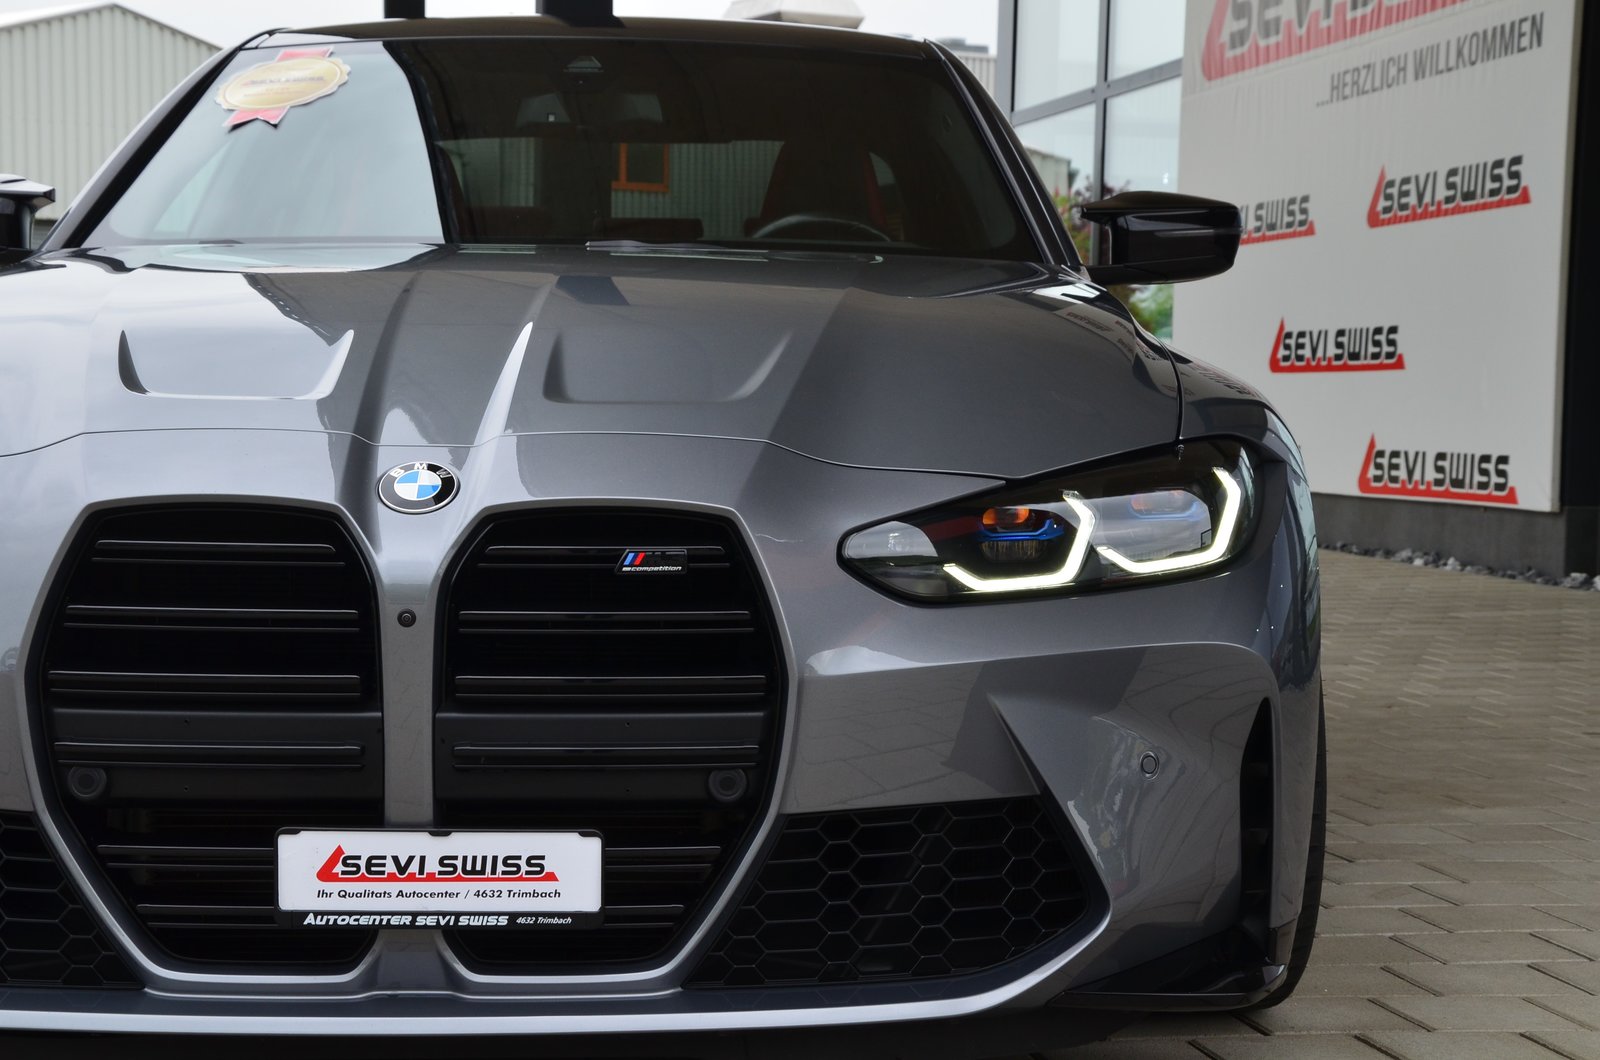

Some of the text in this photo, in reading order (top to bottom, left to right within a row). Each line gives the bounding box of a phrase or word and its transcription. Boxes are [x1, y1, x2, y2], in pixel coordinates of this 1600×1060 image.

[1413, 12, 1545, 82] WILLKOMMEN
[1381, 154, 1524, 216] SEVI SWISS
[1253, 194, 1311, 234] SWISS
[1281, 325, 1399, 363] SEVI SWISS
[389, 462, 452, 478] BMW
[1372, 450, 1510, 493] SEVI SWISS
[340, 854, 546, 877] SEVI SWISS
[316, 889, 333, 899] Ihr
[337, 888, 393, 900] Qualitats
[395, 889, 461, 899] Autocenter
[473, 889, 503, 899] 4632
[506, 889, 561, 899] Trimbach
[303, 912, 572, 926] AUTOCENTER SEVI SWISS 4632 Trimbach
